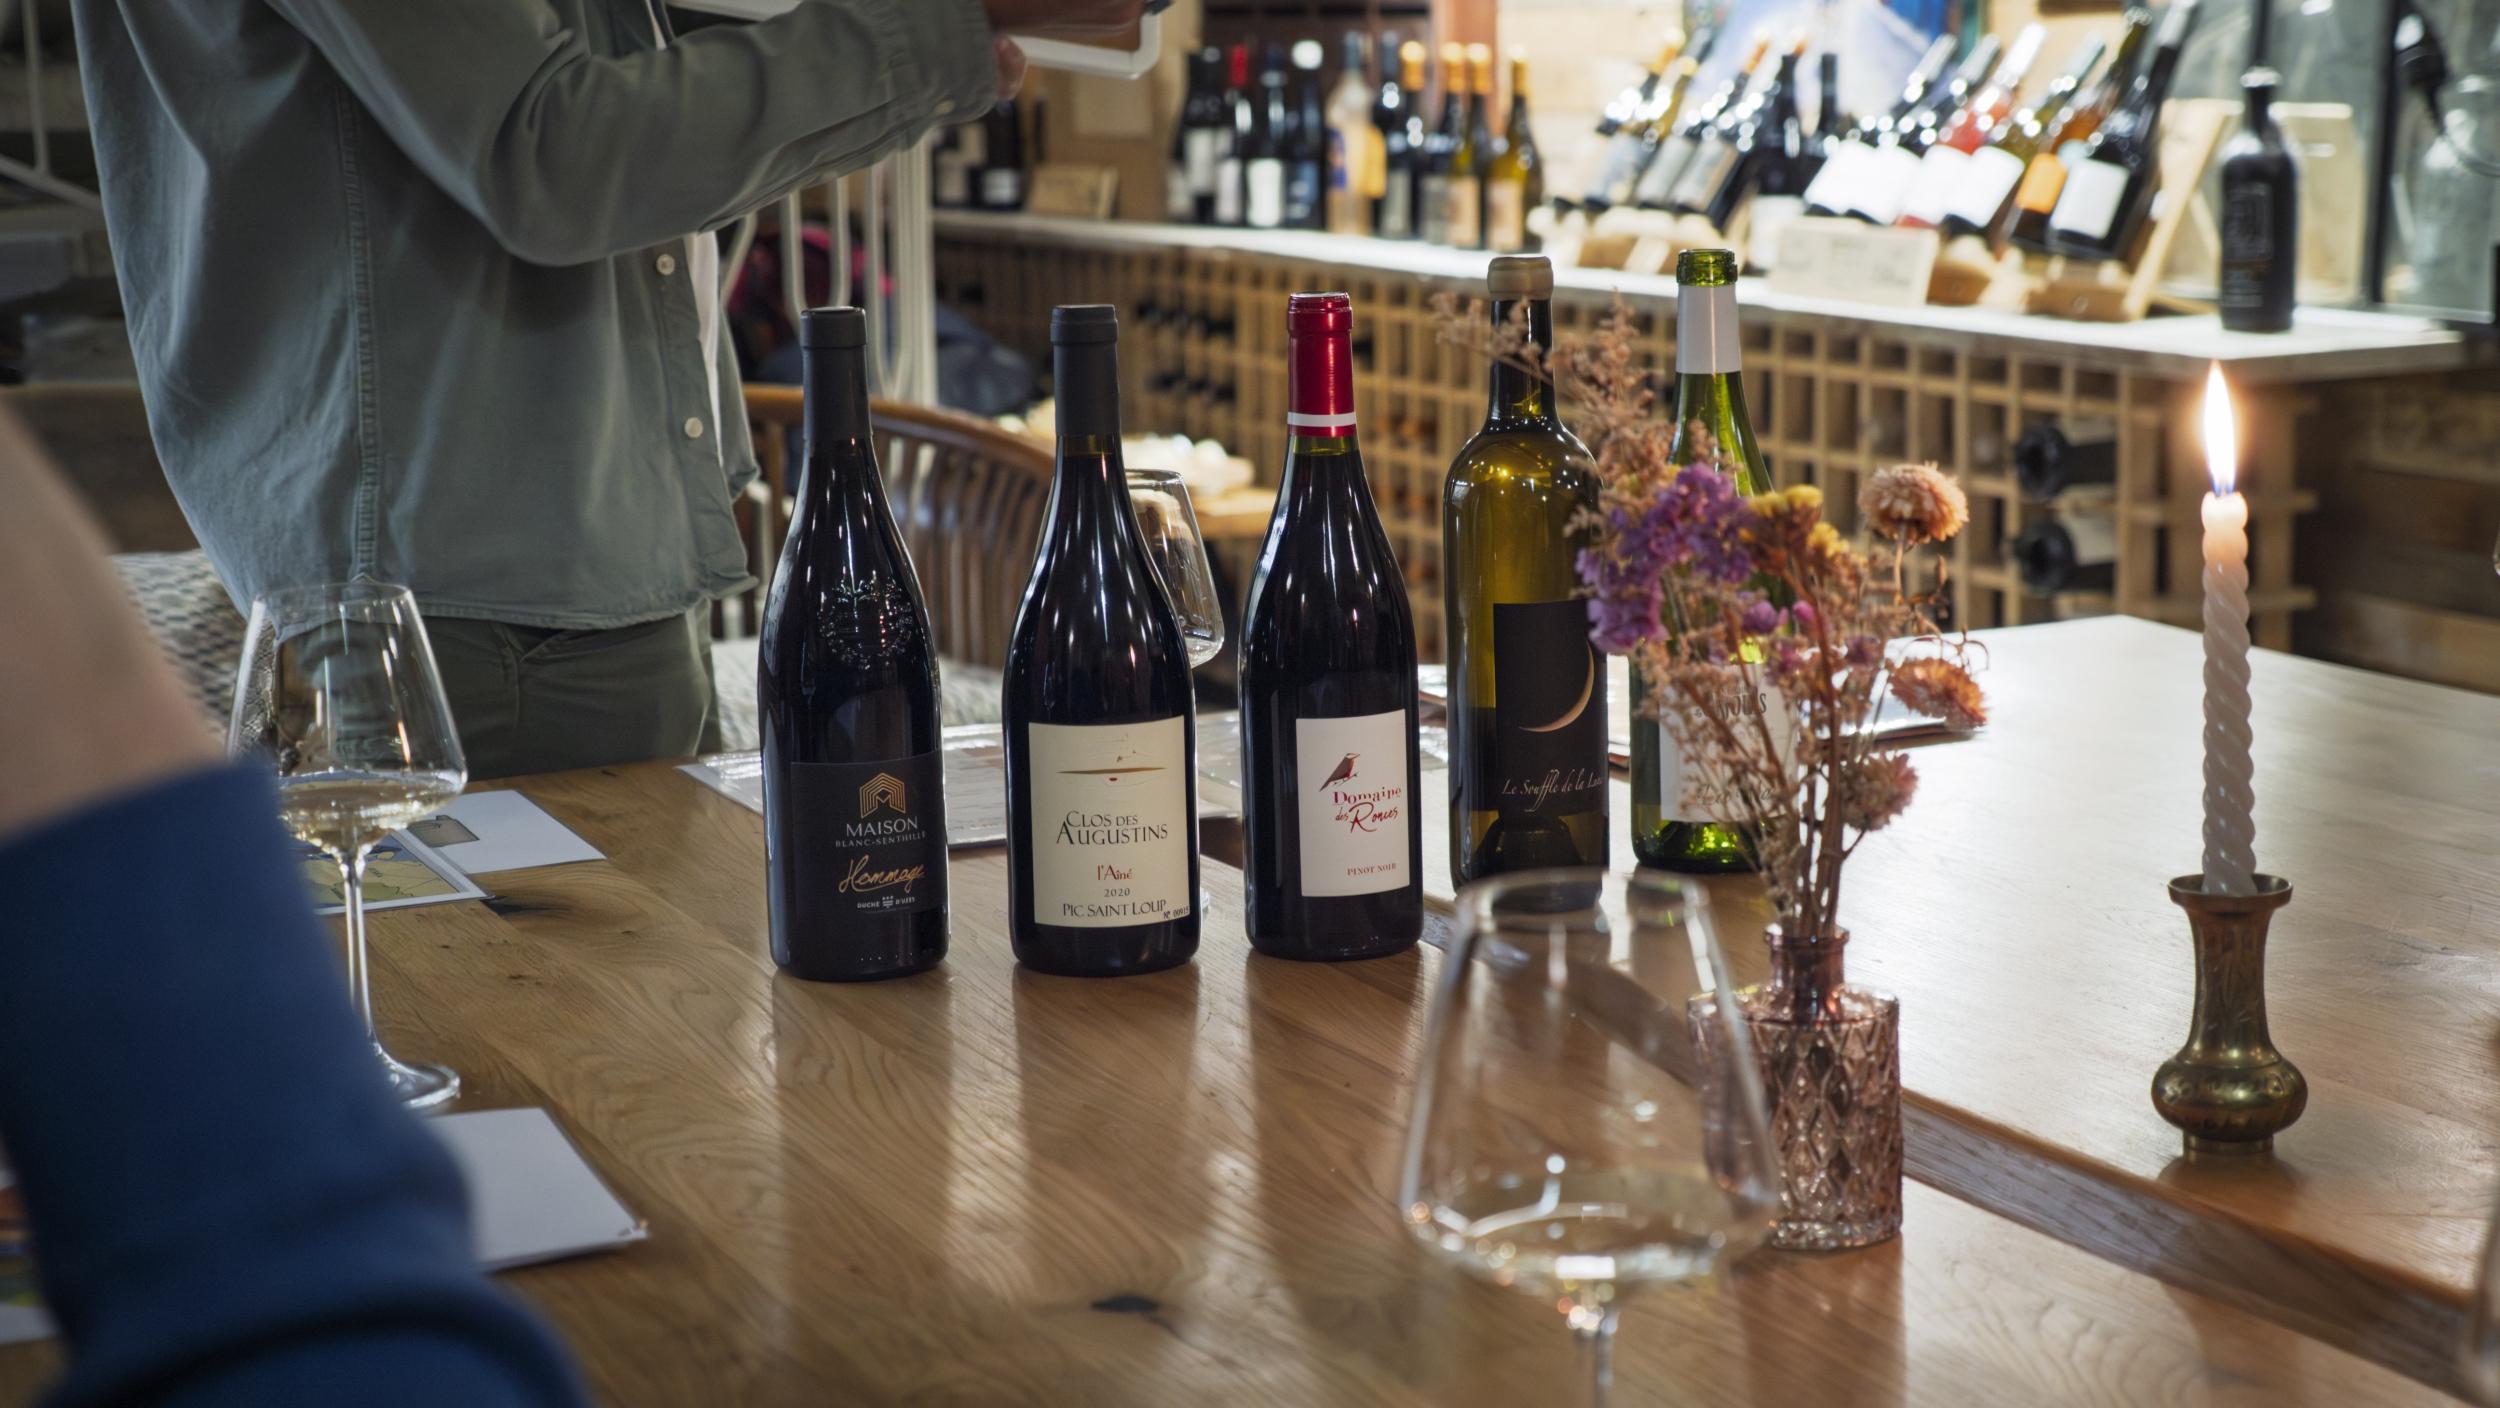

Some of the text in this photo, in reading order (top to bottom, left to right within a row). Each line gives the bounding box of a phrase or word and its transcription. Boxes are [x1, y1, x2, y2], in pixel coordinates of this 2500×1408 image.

[1332, 786, 1402, 806] Domaine
[1502, 778, 1518, 795] Le
[1520, 769, 1560, 813] Souffle
[1561, 768, 1575, 793] de
[1575, 767, 1585, 791] la
[846, 816, 918, 837] MAISON
[1066, 810, 1138, 828] CLOS DES
[1335, 802, 1399, 833] des Ronces
[1056, 820, 1169, 845] AUGUSTINS
[839, 854, 925, 894] Hommage
[1097, 864, 1133, 881] l'Aîné
[1346, 863, 1397, 876] PINOT NOIR
[1104, 887, 1131, 898] 2020
[1063, 899, 1167, 917] PIC SAINT LOUP
